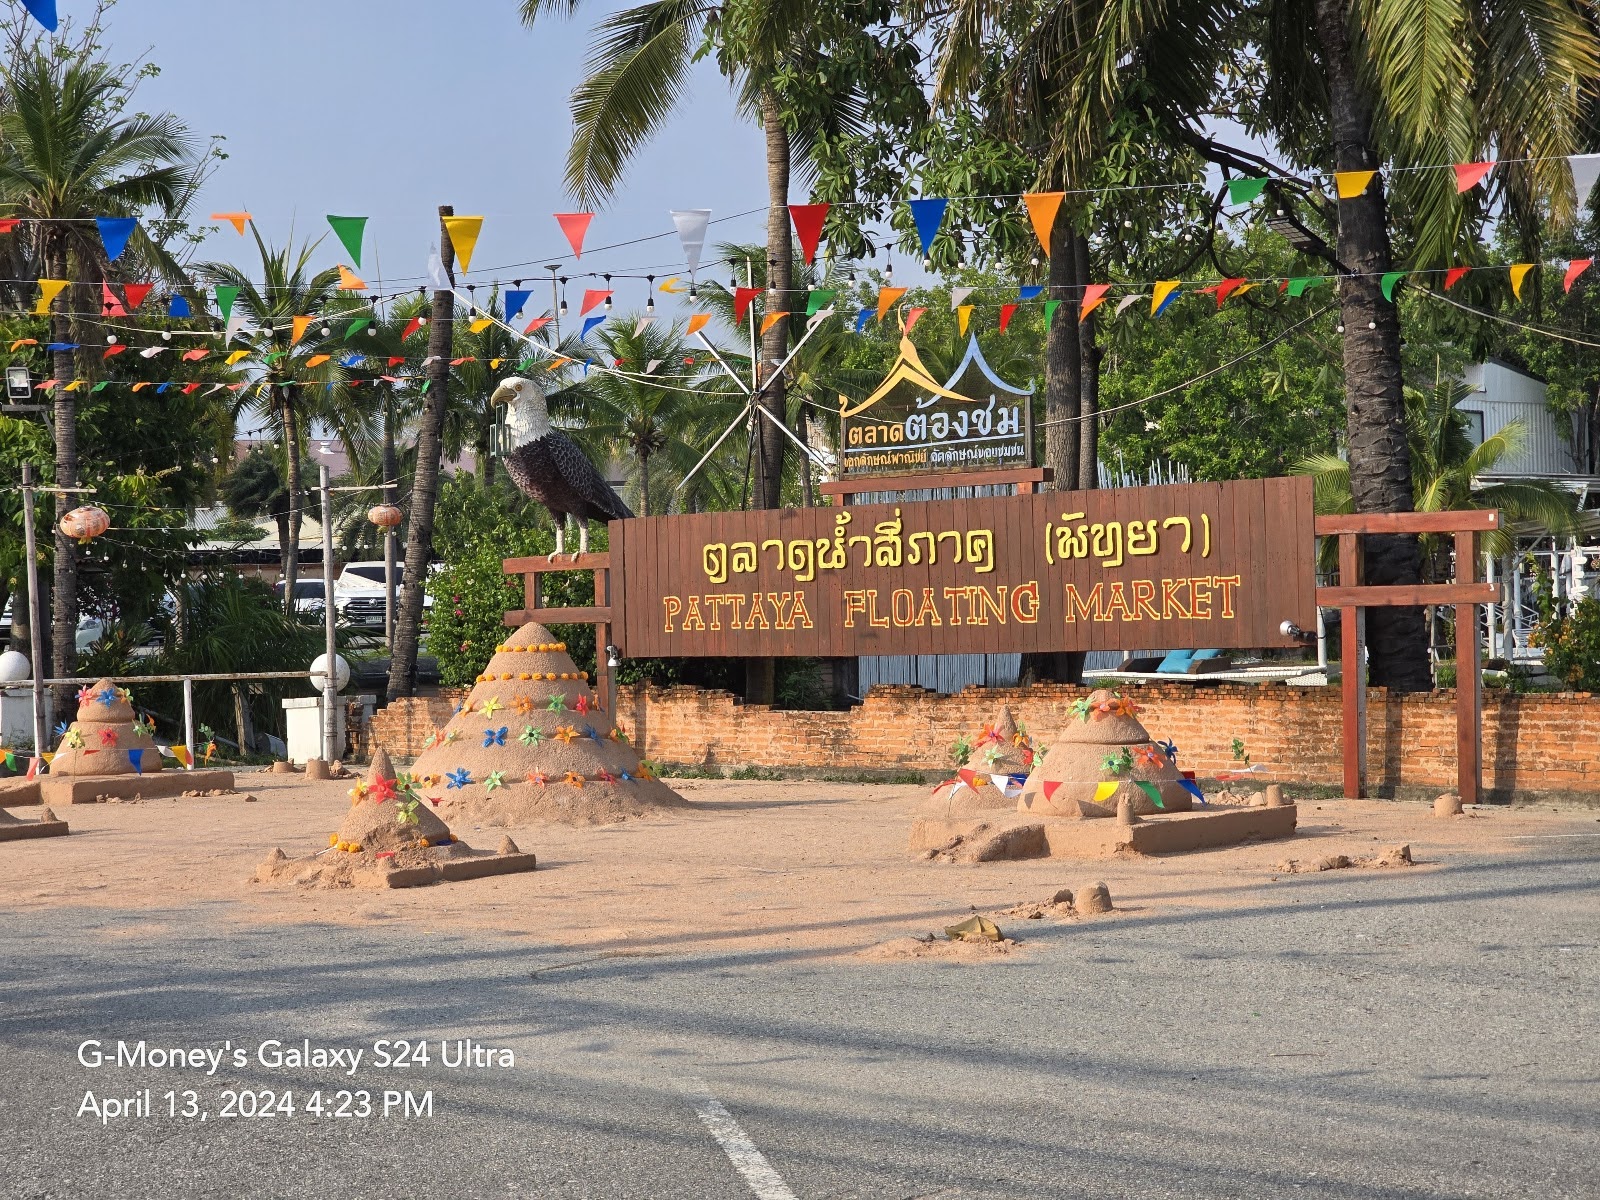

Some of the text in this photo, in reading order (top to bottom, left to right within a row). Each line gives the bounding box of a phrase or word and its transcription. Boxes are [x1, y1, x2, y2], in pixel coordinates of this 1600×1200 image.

[663, 574, 1241, 632] PATTAYA FLOATING MARKET
